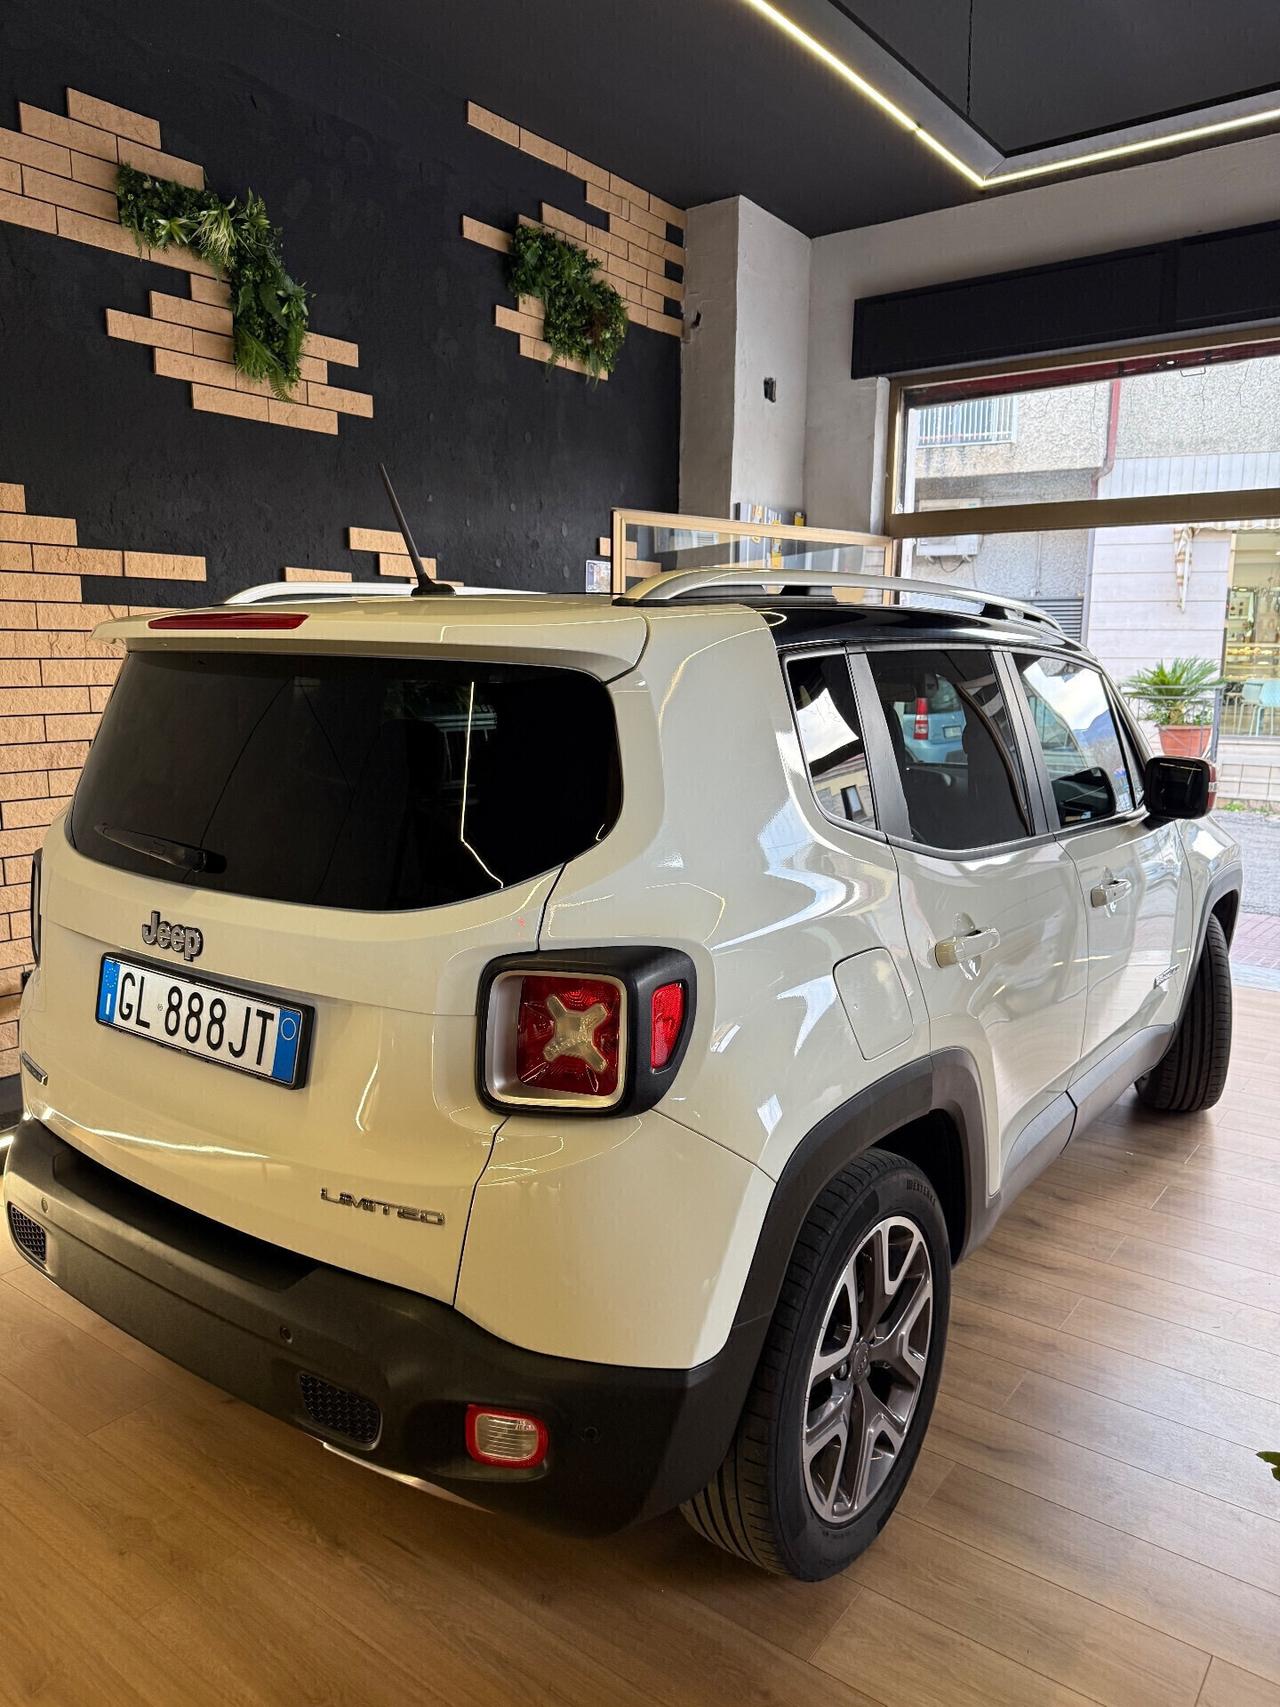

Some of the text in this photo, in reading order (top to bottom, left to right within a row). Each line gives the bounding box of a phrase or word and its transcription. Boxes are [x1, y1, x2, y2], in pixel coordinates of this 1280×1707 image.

[142, 910, 204, 962] Jeep
[118, 972, 275, 1066] GL 888JT
[320, 1186, 446, 1226] LIMITED
